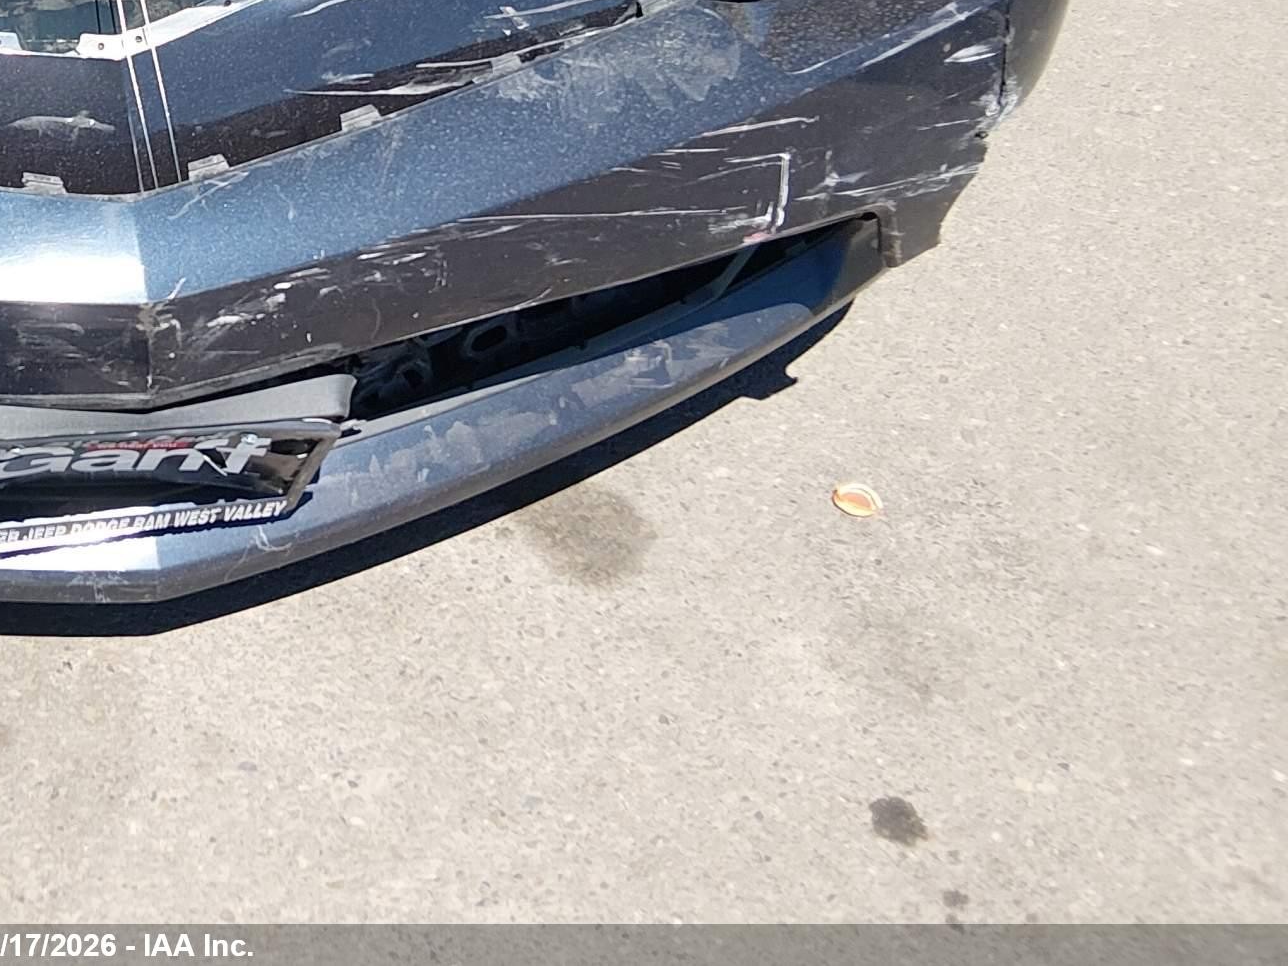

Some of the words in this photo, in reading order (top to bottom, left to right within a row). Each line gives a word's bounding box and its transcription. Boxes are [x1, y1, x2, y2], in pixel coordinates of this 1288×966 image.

[132, 512, 172, 531] RAM
[173, 507, 221, 528] WEST
[223, 500, 287, 522] VALLEY
